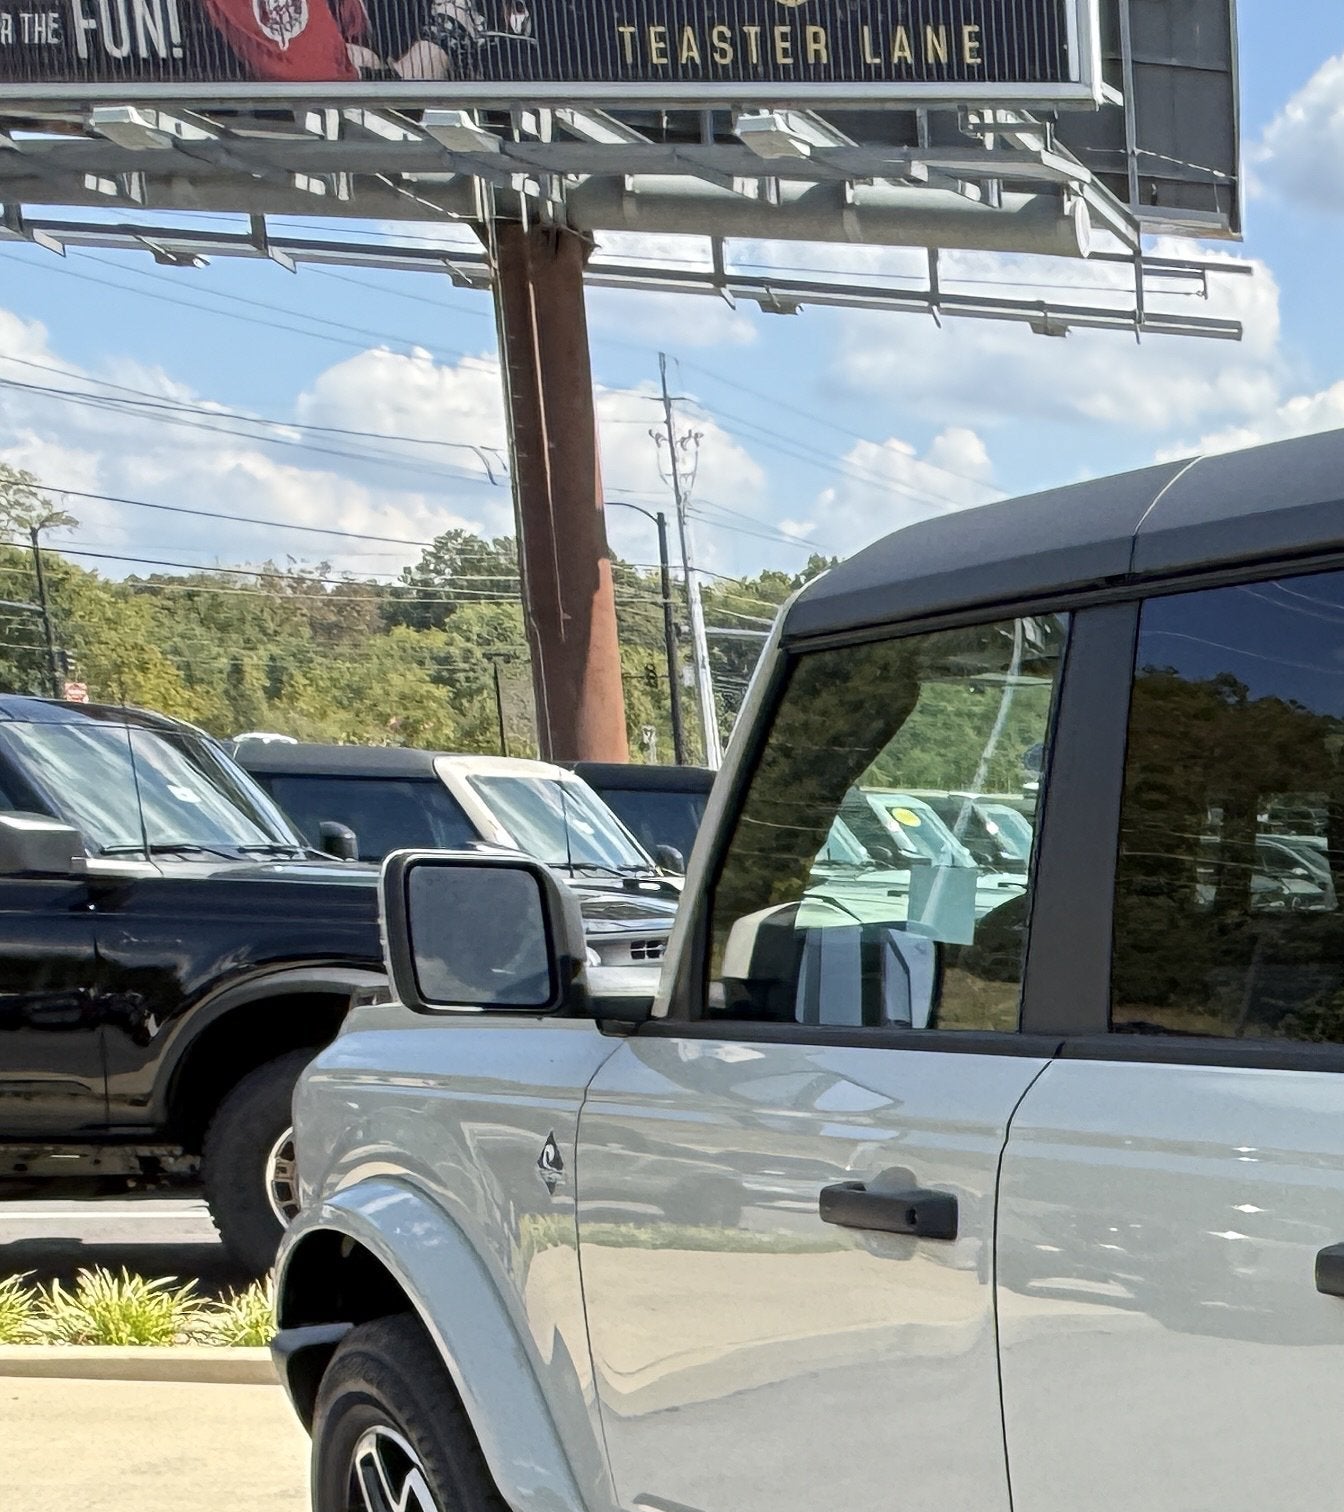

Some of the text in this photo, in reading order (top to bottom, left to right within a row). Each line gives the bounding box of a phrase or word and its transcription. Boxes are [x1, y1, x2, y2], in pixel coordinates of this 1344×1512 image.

[19, 12, 59, 44] THE
[72, 0, 184, 59] FUN!
[617, 24, 983, 65] TEASTER LANE
